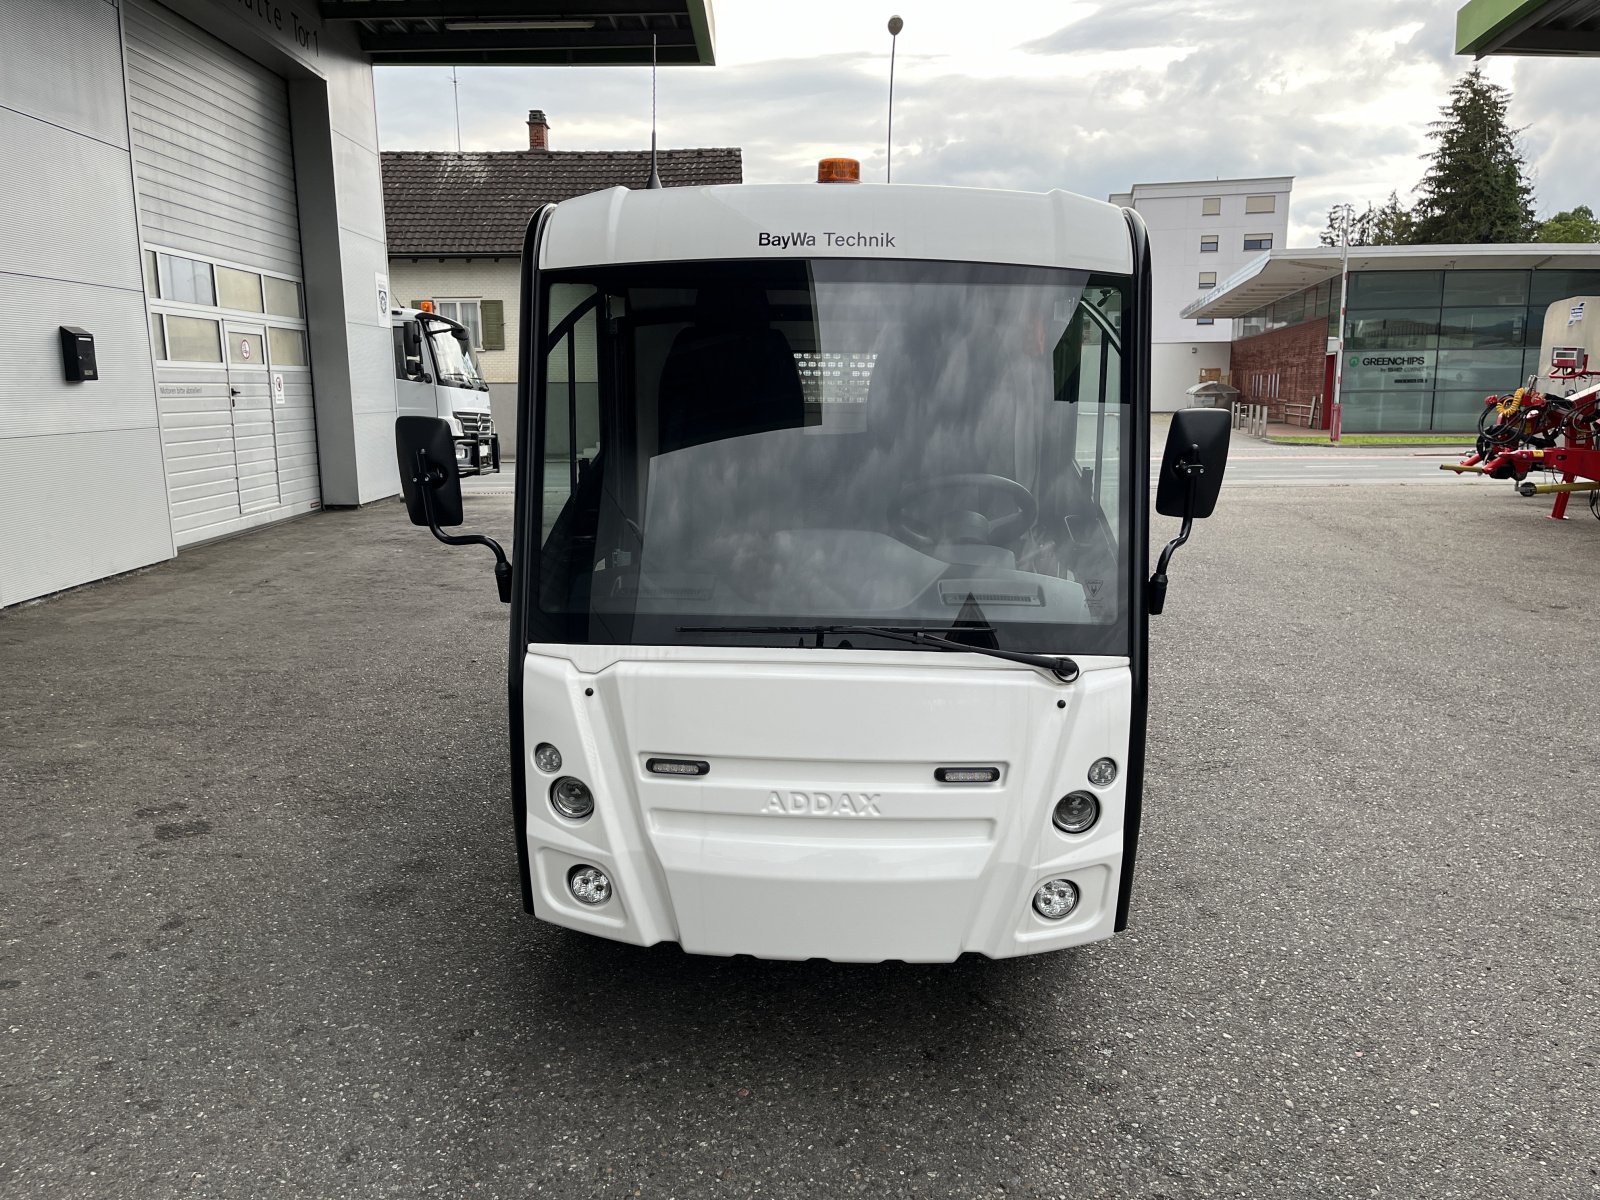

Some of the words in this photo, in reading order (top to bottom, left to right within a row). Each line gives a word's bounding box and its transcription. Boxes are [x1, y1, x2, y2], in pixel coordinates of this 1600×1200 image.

[290, 11, 310, 51] Tor
[313, 29, 319, 58] 1
[758, 232, 816, 250] BayWa
[823, 231, 896, 248] Technik
[1362, 356, 1425, 366] GREENCHIPS
[760, 790, 881, 816] ADDAX
